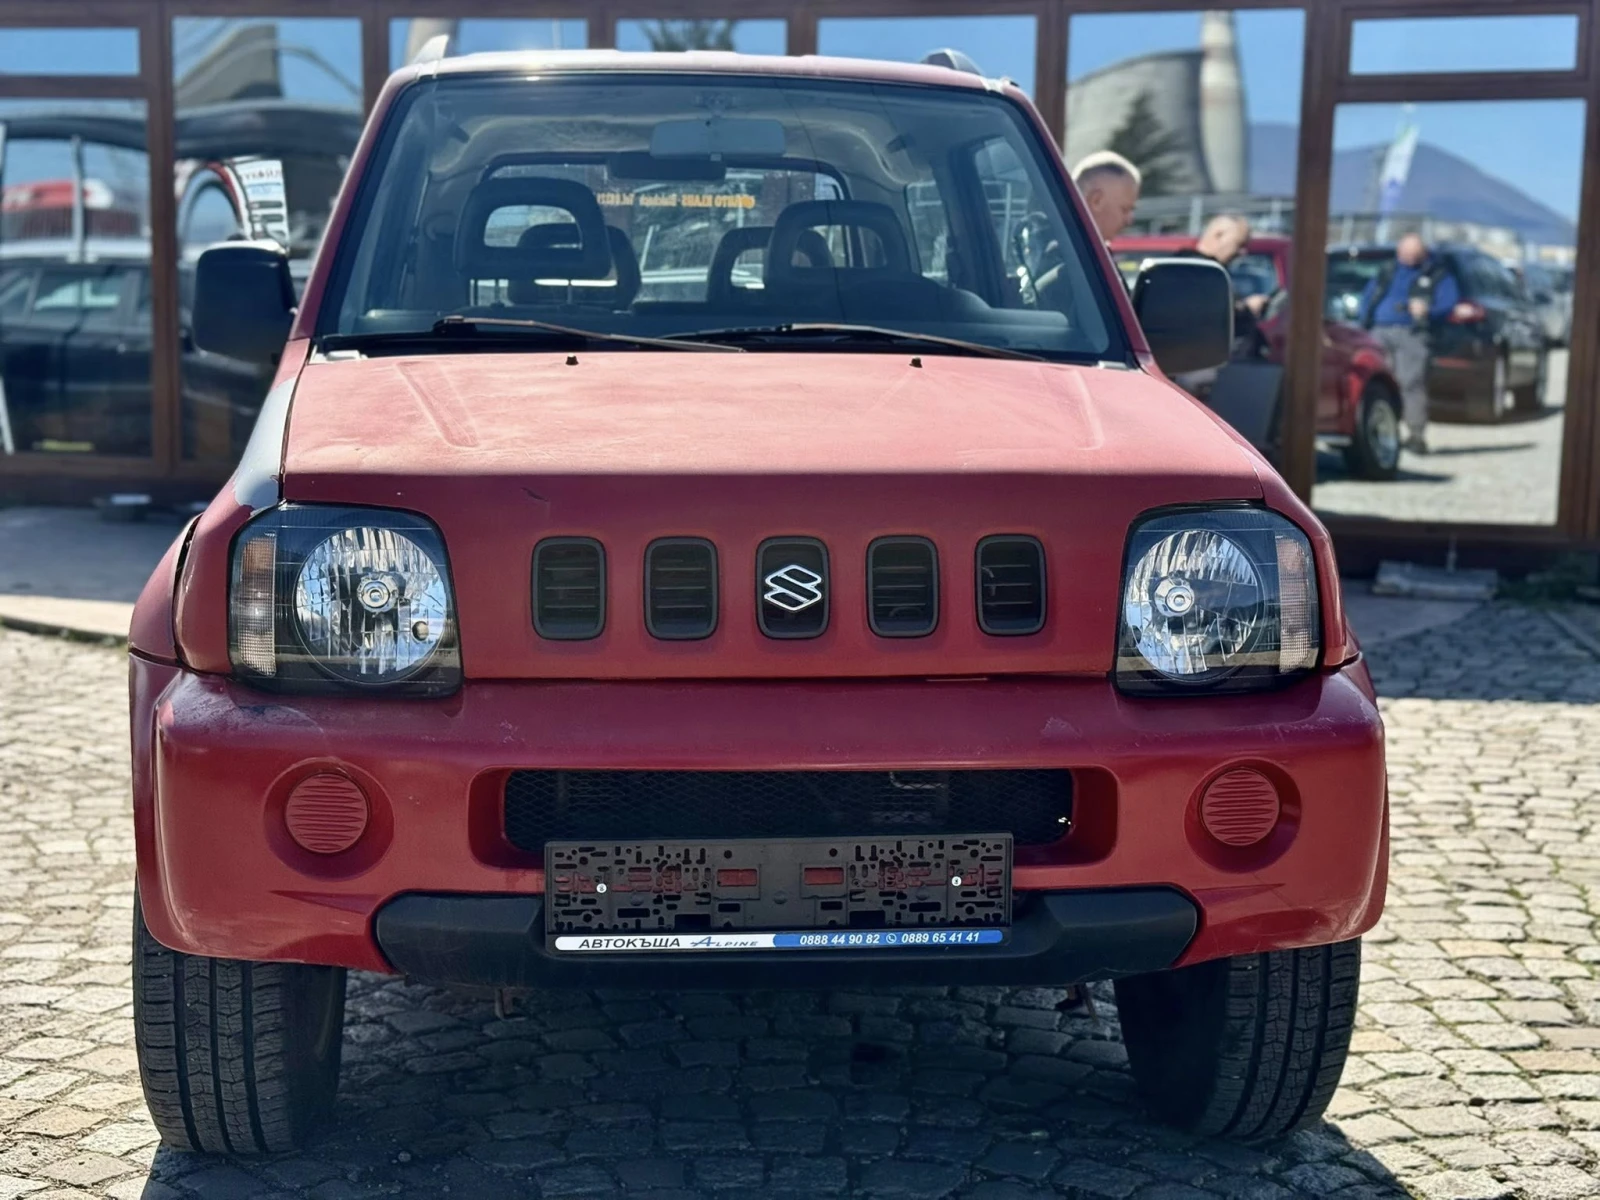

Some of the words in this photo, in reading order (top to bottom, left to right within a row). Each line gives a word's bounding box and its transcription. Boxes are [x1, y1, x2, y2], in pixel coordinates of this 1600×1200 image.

[799, 934, 828, 945] 0888
[830, 933, 845, 944] 44
[848, 933, 864, 944] 90
[866, 933, 880, 944] 82
[901, 932, 929, 943] 0889
[932, 932, 946, 943] 65
[949, 931, 962, 942] 41
[965, 931, 981, 942] 41
